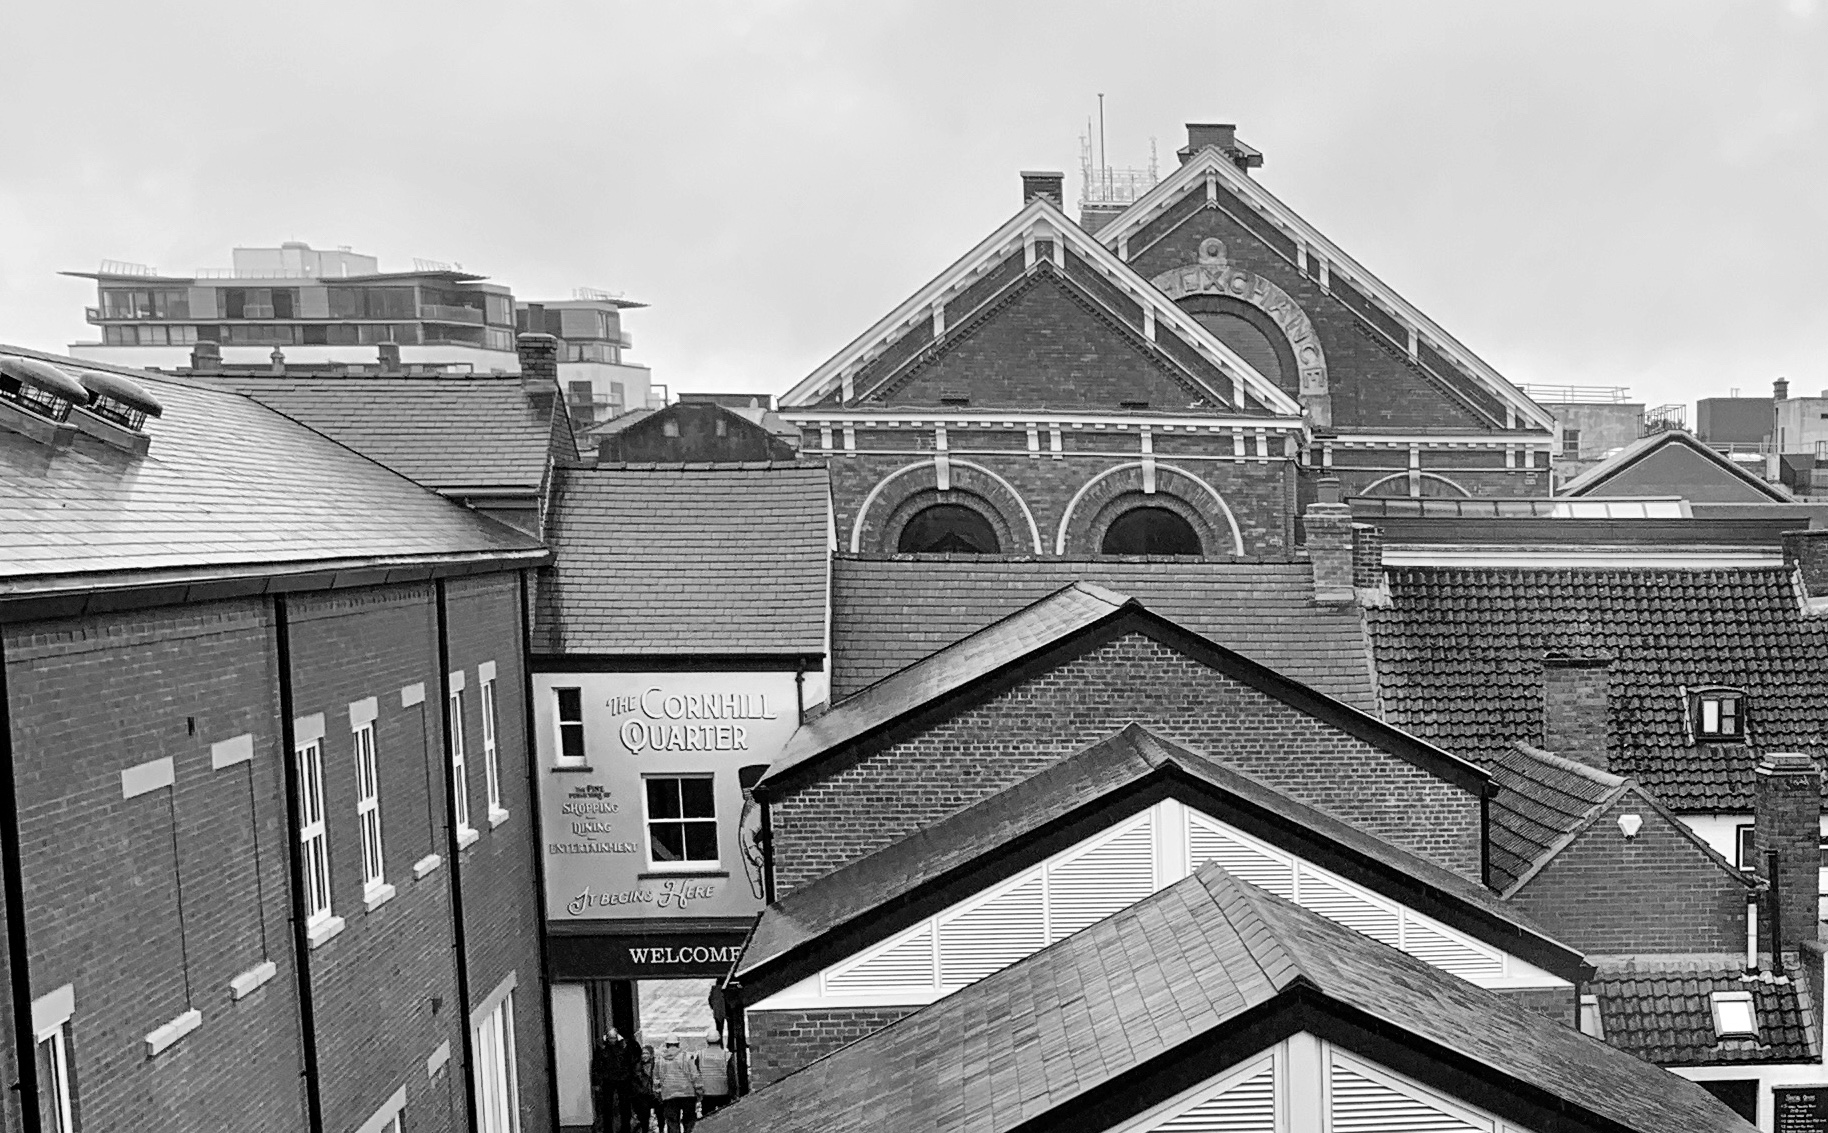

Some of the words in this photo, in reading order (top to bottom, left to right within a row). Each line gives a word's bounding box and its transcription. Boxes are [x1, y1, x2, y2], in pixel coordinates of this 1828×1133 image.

[606, 694, 637, 716] THE
[640, 687, 778, 720] CORNHILL
[620, 720, 748, 754] QUARTER
[562, 802, 619, 817] SHOPPING
[572, 821, 612, 837] DINING
[549, 842, 638, 854] ENTERTAINMENT
[629, 946, 742, 964] WELCOME
